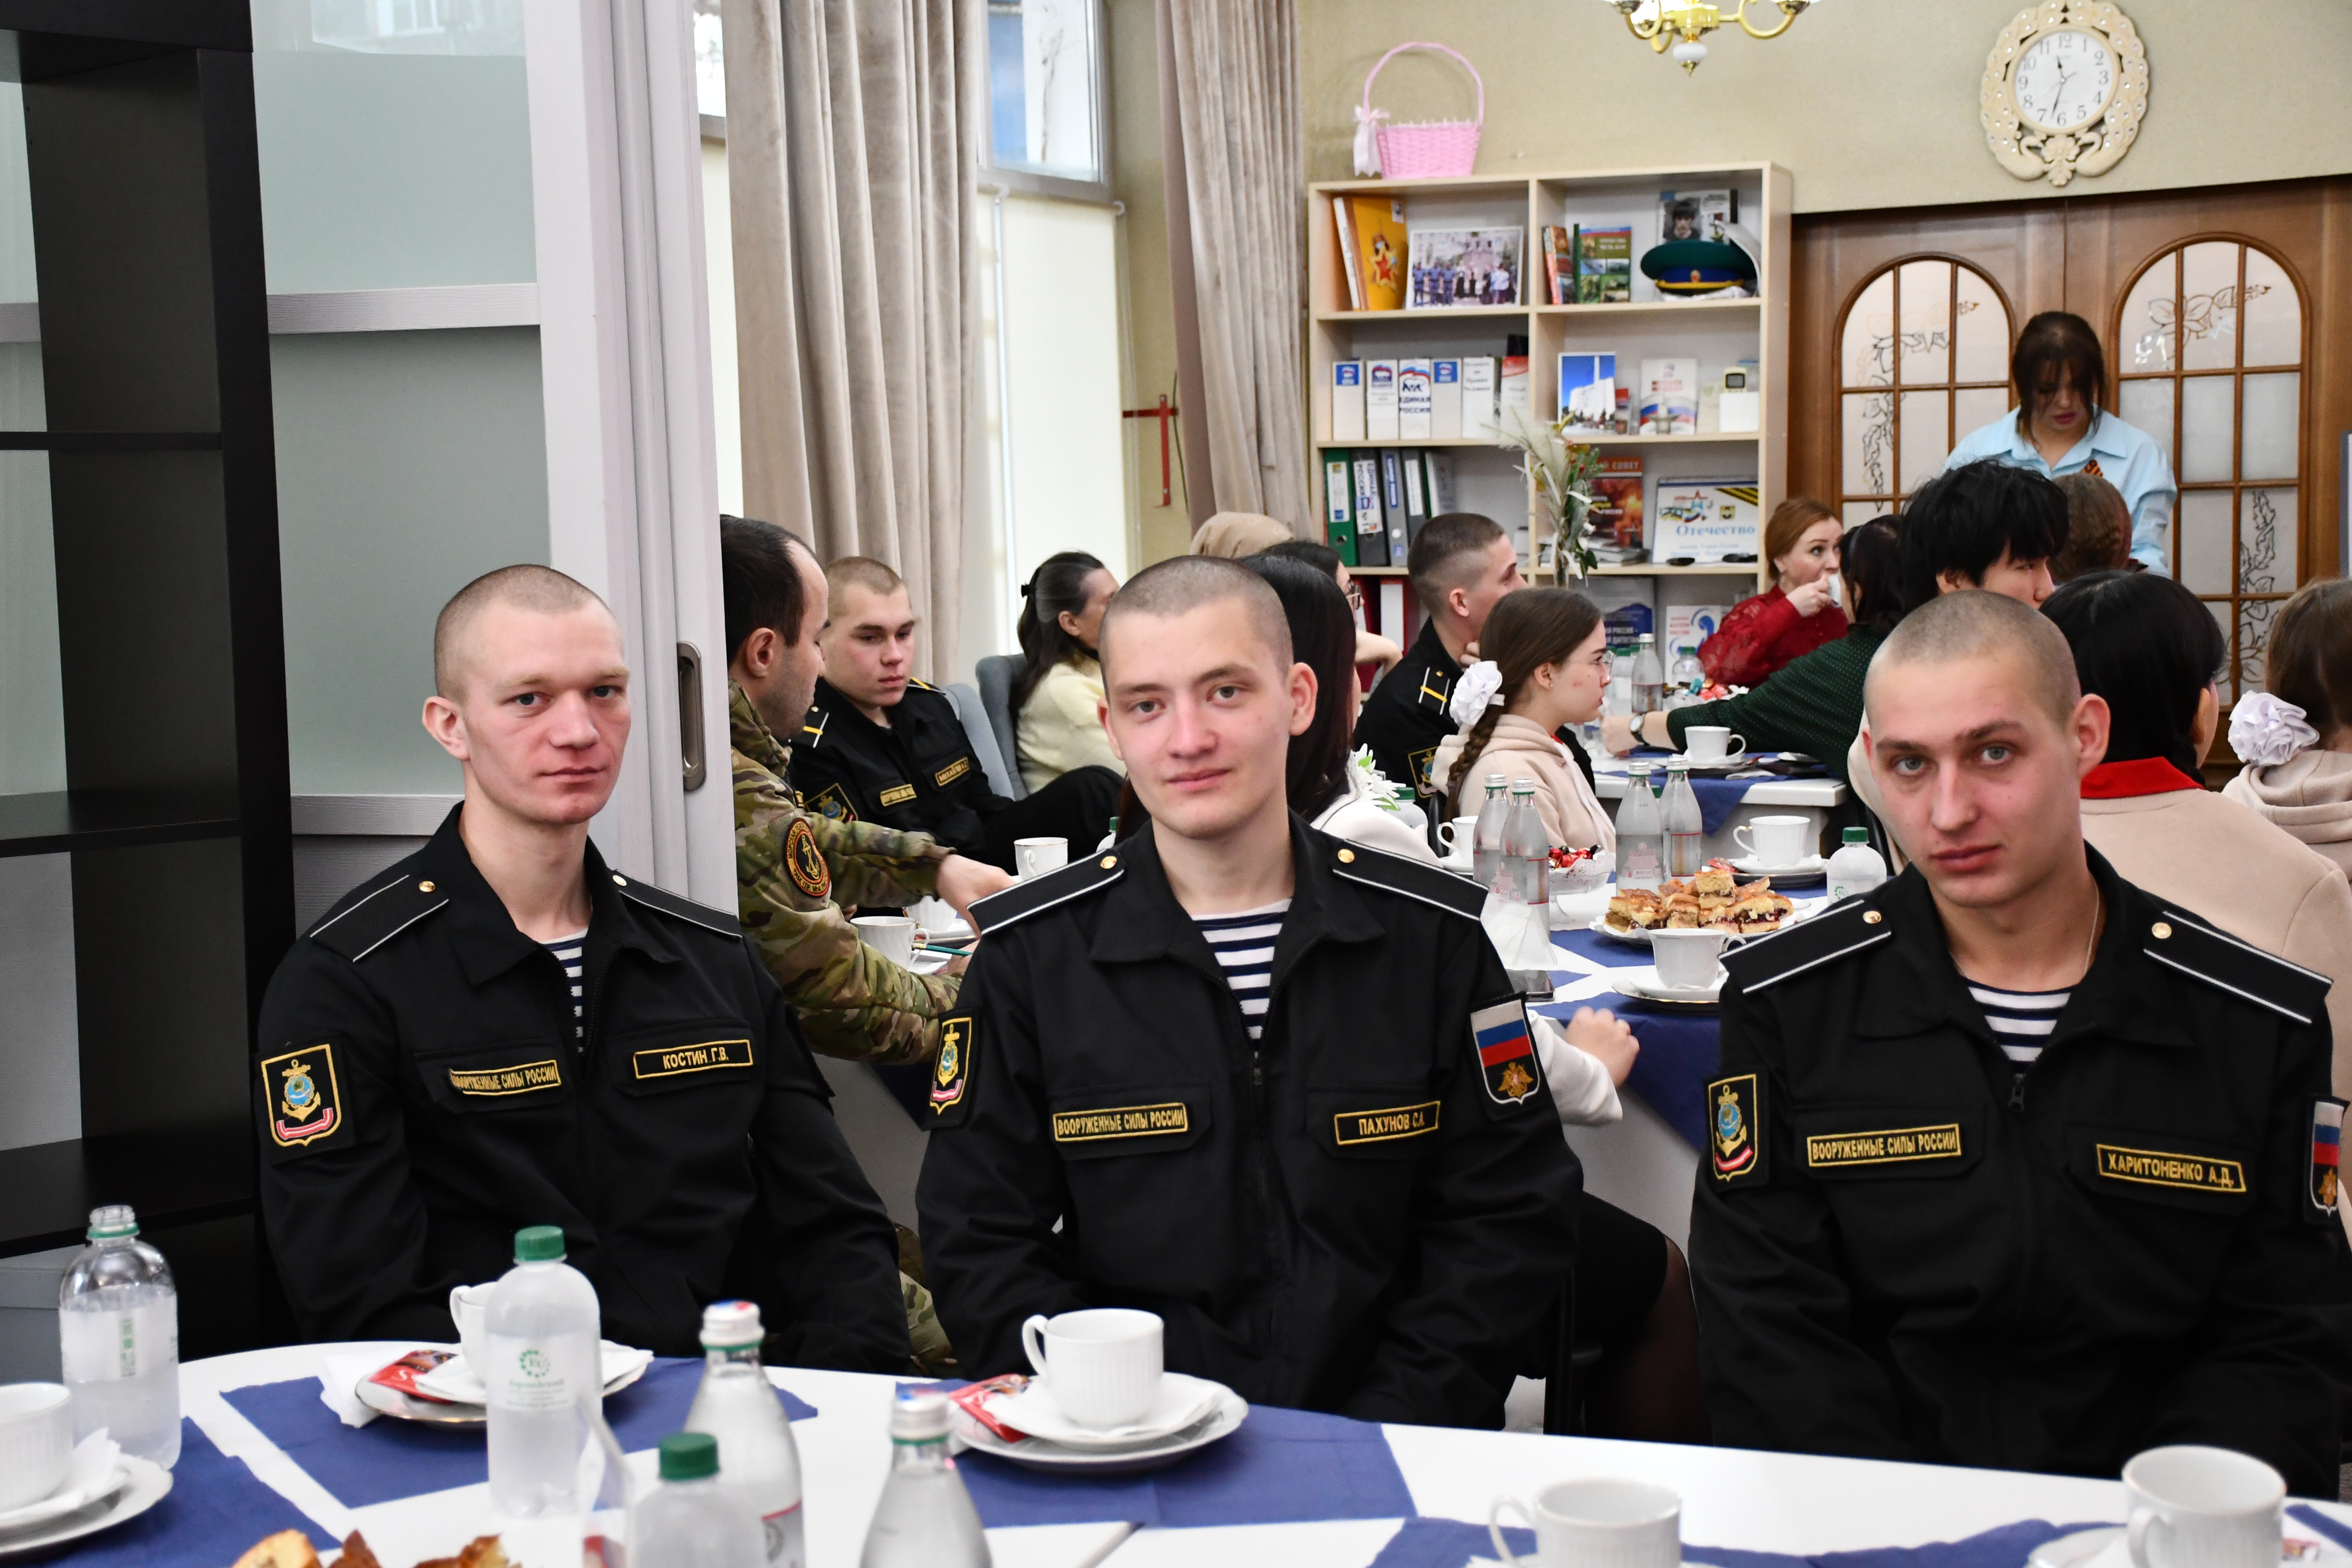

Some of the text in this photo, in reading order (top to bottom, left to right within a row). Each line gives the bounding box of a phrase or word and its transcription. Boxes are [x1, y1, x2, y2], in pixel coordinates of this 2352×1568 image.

[2040, 39, 2050, 55] 11
[2058, 33, 2072, 49] 12
[2082, 37, 2087, 52] 1
[2022, 55, 2036, 71] 10
[2094, 51, 2104, 66] 2
[2018, 76, 2028, 90] 9
[2099, 70, 2108, 85] 3
[2023, 95, 2033, 109] 8
[2093, 90, 2102, 105] 4
[2037, 109, 2047, 122] 7
[2057, 112, 2066, 127] 6
[2077, 104, 2087, 120] 5
[1676, 525, 1756, 535] Отечество
[663, 1049, 708, 1069] КОСТИН
[501, 1071, 525, 1089] СИЛЫ
[525, 1066, 557, 1085] РОССИИ
[1057, 1109, 1184, 1135] ВООРУЖЕННЫЕ СИЛЫ РОССИИ
[1358, 1114, 1410, 1135] ПАХУНОВ
[1812, 1131, 1957, 1160] ВООРУЖЕННЫЕ СИЛЫ РОССИИ
[2107, 1153, 2204, 1181] ХАРИТОНЕНКО
